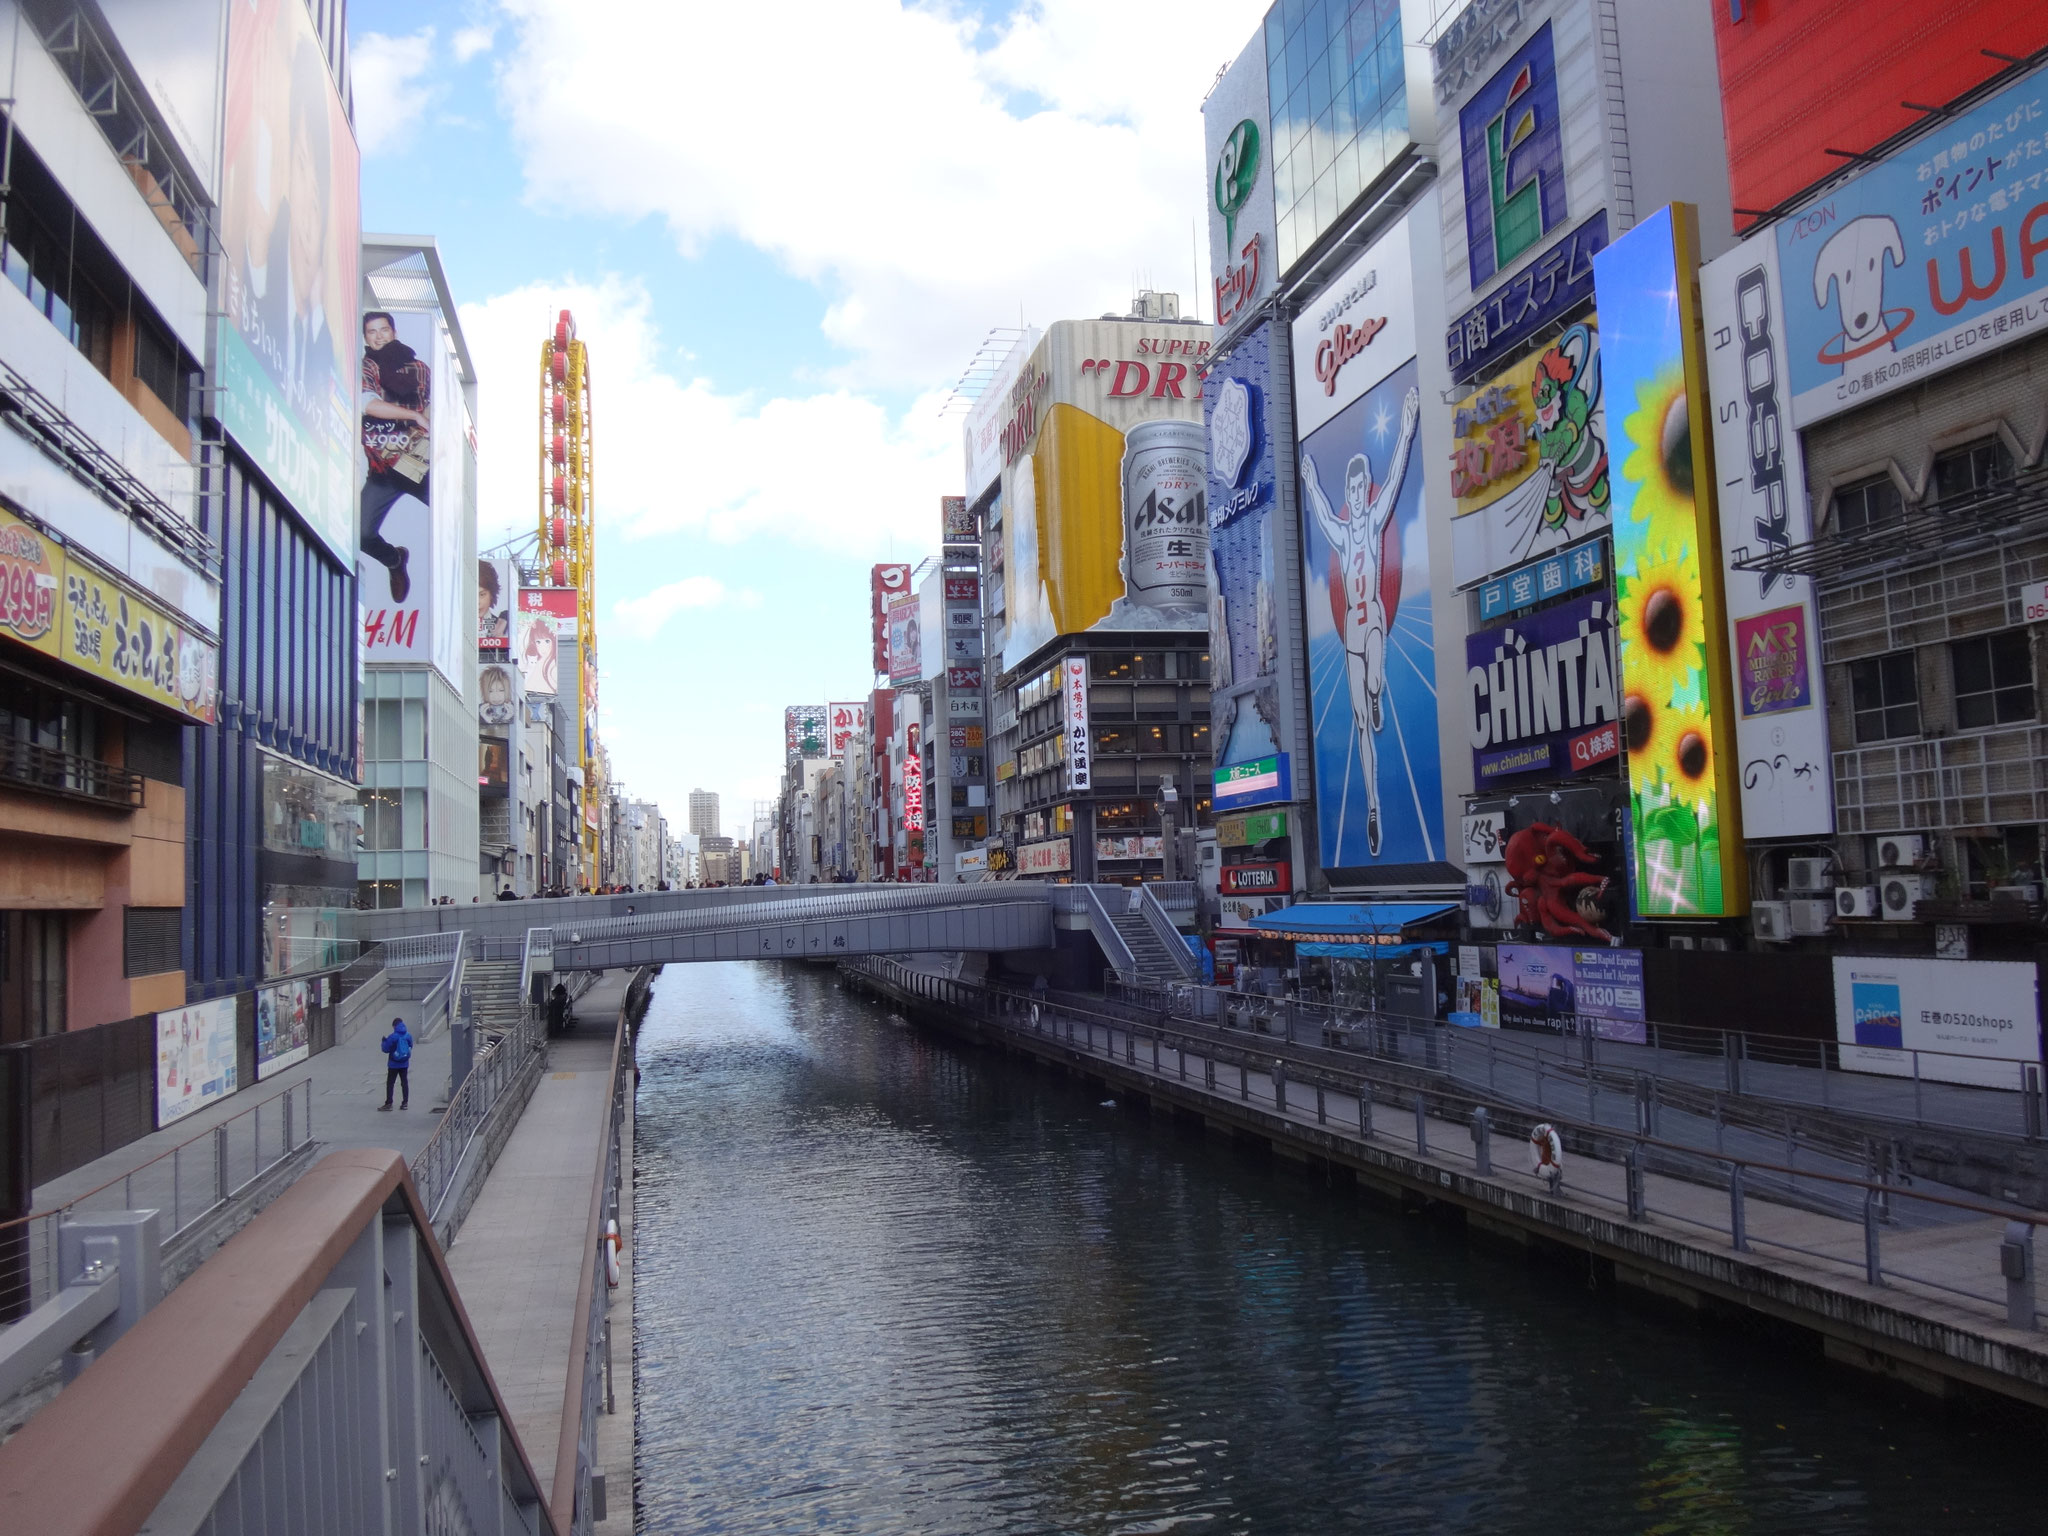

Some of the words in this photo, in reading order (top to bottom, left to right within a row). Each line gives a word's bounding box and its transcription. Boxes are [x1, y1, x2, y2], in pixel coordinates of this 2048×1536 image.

[1917, 98, 2042, 182] お買物のたびに
[1921, 134, 2048, 216] ポイントがた
[1215, 232, 1261, 327] ピップ
[1445, 235, 1596, 373] 日商エステム
[1137, 337, 1211, 357] SUPER
[1453, 383, 1521, 440] かぜに
[364, 421, 396, 433] シャツ
[365, 434, 410, 448] ¥999
[1449, 411, 1530, 499] 改源
[1210, 482, 1259, 530] 雪印メグミルク
[1167, 539, 1193, 557] 生
[1156, 560, 1206, 571] スーパードライ
[1170, 588, 1193, 598] 350ml
[1353, 545, 1369, 626] グリコ
[365, 609, 420, 649] H&M
[1746, 620, 1799, 659] MR
[1749, 649, 1798, 672] MILLION
[1753, 663, 1796, 683] RACER
[950, 699, 980, 712] 白木屋
[1072, 678, 1084, 721] 本場の味
[1589, 730, 1616, 757] 検索
[1072, 725, 1088, 786] かに道楽
[1229, 763, 1262, 782] 大阪ニュース
[903, 754, 923, 831] 大阪王将
[1470, 818, 1497, 855] くくる
[1237, 870, 1275, 887] LOTTERIA
[762, 935, 846, 951] えびす橋
[1597, 953, 1616, 968] Rapid
[1616, 954, 1640, 969] Express
[1617, 969, 1641, 985] Airport
[1547, 1016, 1576, 1031] rapt?
[1920, 1010, 2014, 1032] 圧巻の520shops
